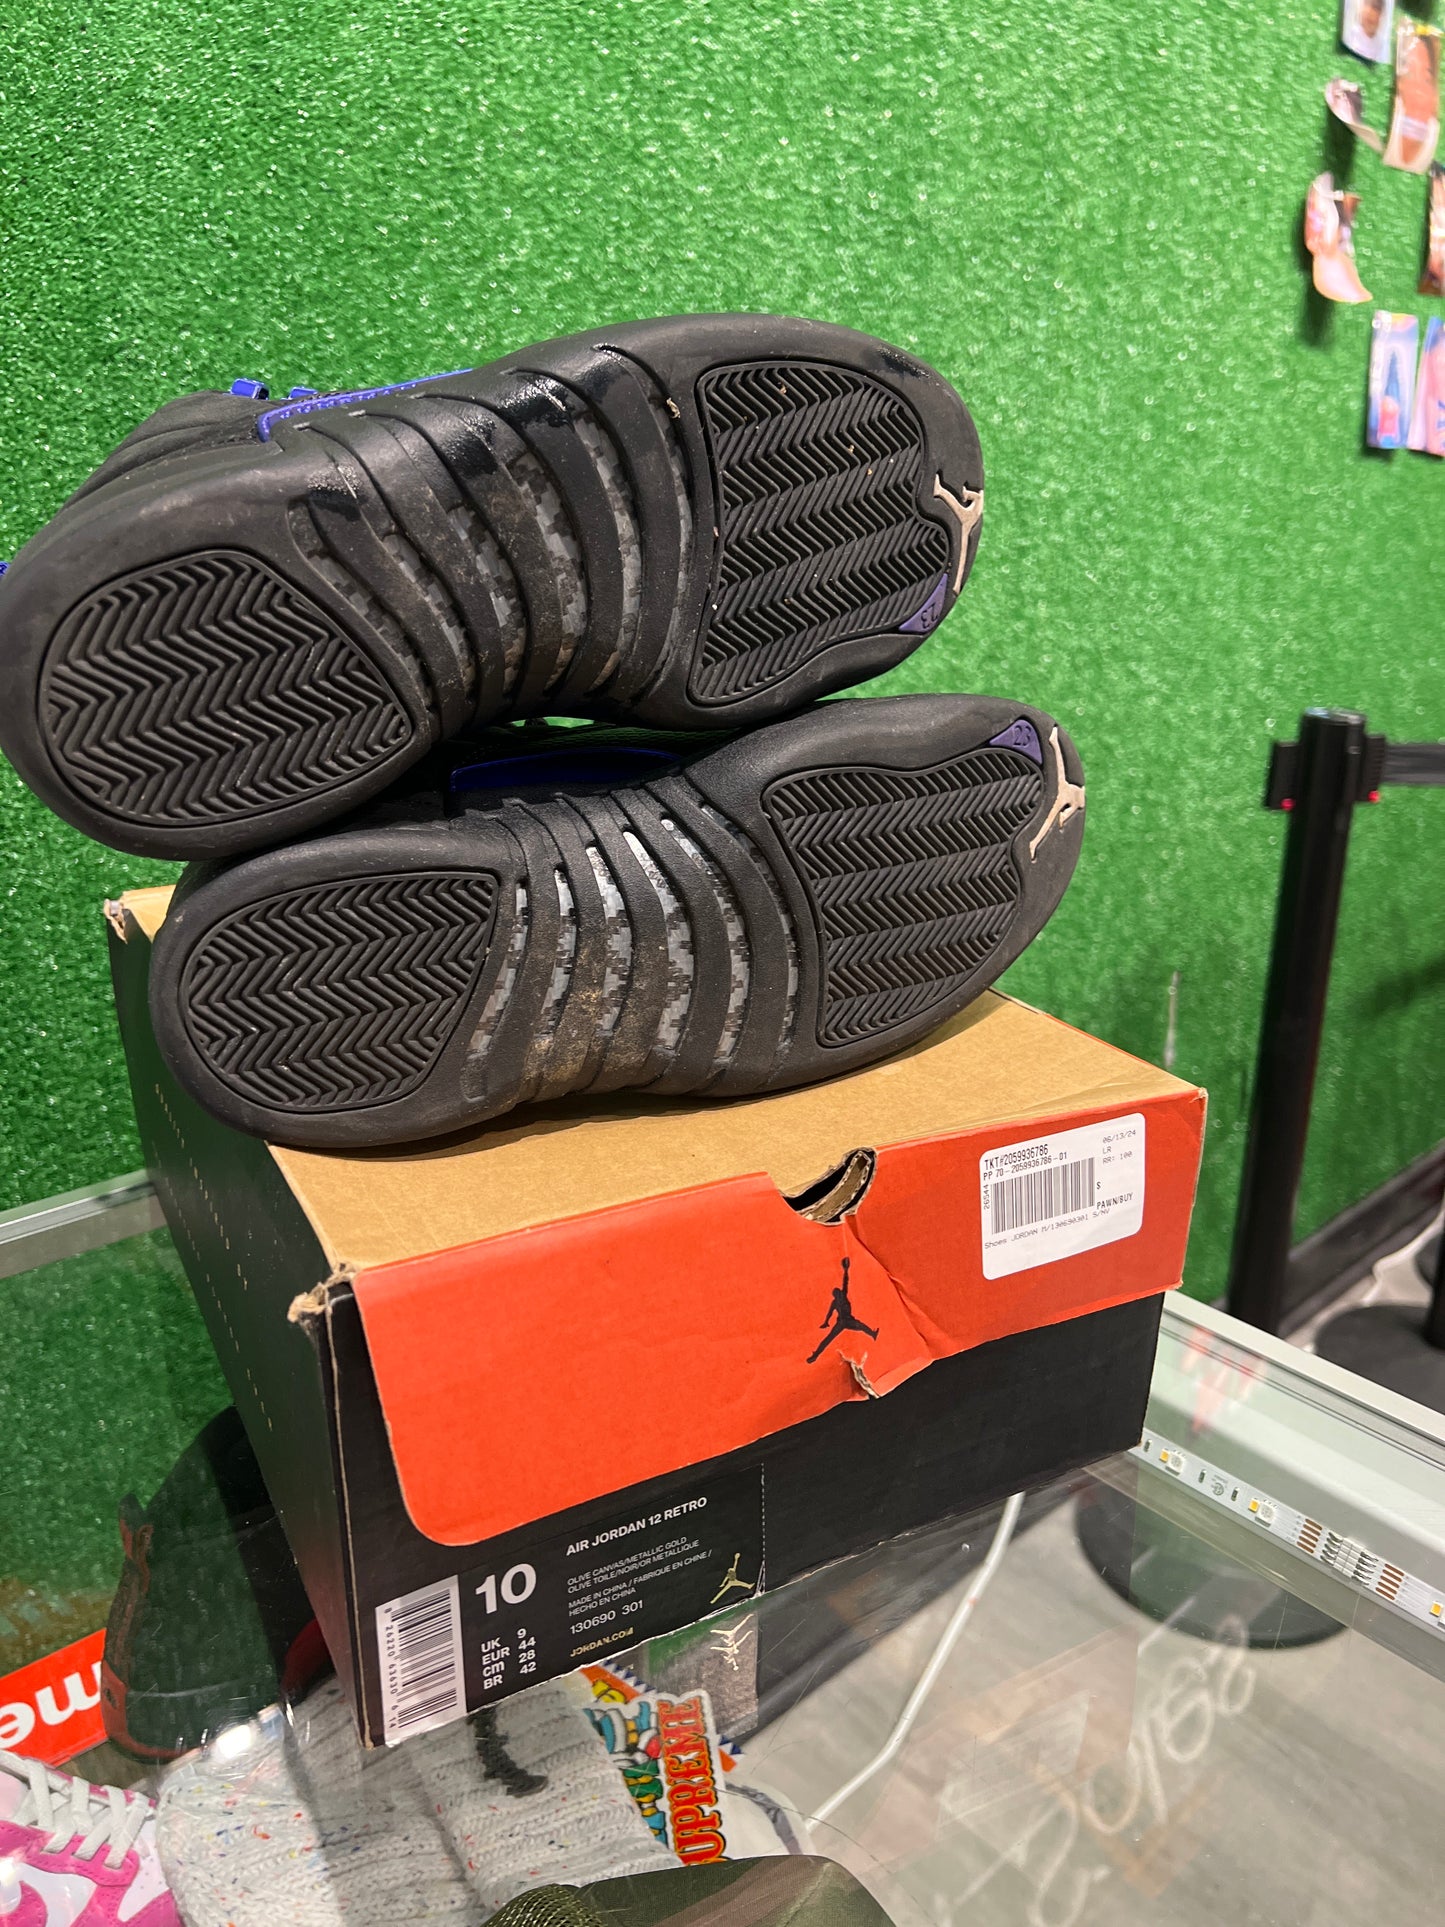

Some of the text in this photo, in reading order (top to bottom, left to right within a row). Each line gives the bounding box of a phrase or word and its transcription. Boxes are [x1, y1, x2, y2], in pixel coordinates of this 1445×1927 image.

[1013, 725, 1032, 748] 23
[983, 1171, 993, 1181] PP
[984, 1238, 1007, 1250] Shoes
[1011, 1227, 1038, 1242] JORDAN
[566, 1497, 707, 1556] AIR JORDAN 12 RETRO
[567, 1536, 687, 1586] OLIVE CANVAS/METALLIC GOLD
[567, 1580, 592, 1594] OLIVE
[594, 1558, 652, 1584] TOILE/NOIR/OR
[475, 1563, 537, 1615] 10
[568, 1594, 592, 1609] MADE
[593, 1590, 601, 1599] IN
[602, 1581, 628, 1596] CHINA
[633, 1565, 671, 1585] FABRIQUE
[672, 1561, 683, 1570] EN
[684, 1552, 707, 1566] CHINE
[569, 1587, 636, 1617] HECHO EN CHINA
[570, 1600, 643, 1635] 130690 301
[385, 1625, 396, 1657] 26220
[480, 1628, 527, 1653] UK 9
[482, 1636, 536, 1665] EUR 44
[482, 1649, 536, 1678] cm 28
[483, 1661, 537, 1690] BR 42
[657, 1695, 728, 1866] UPREME
